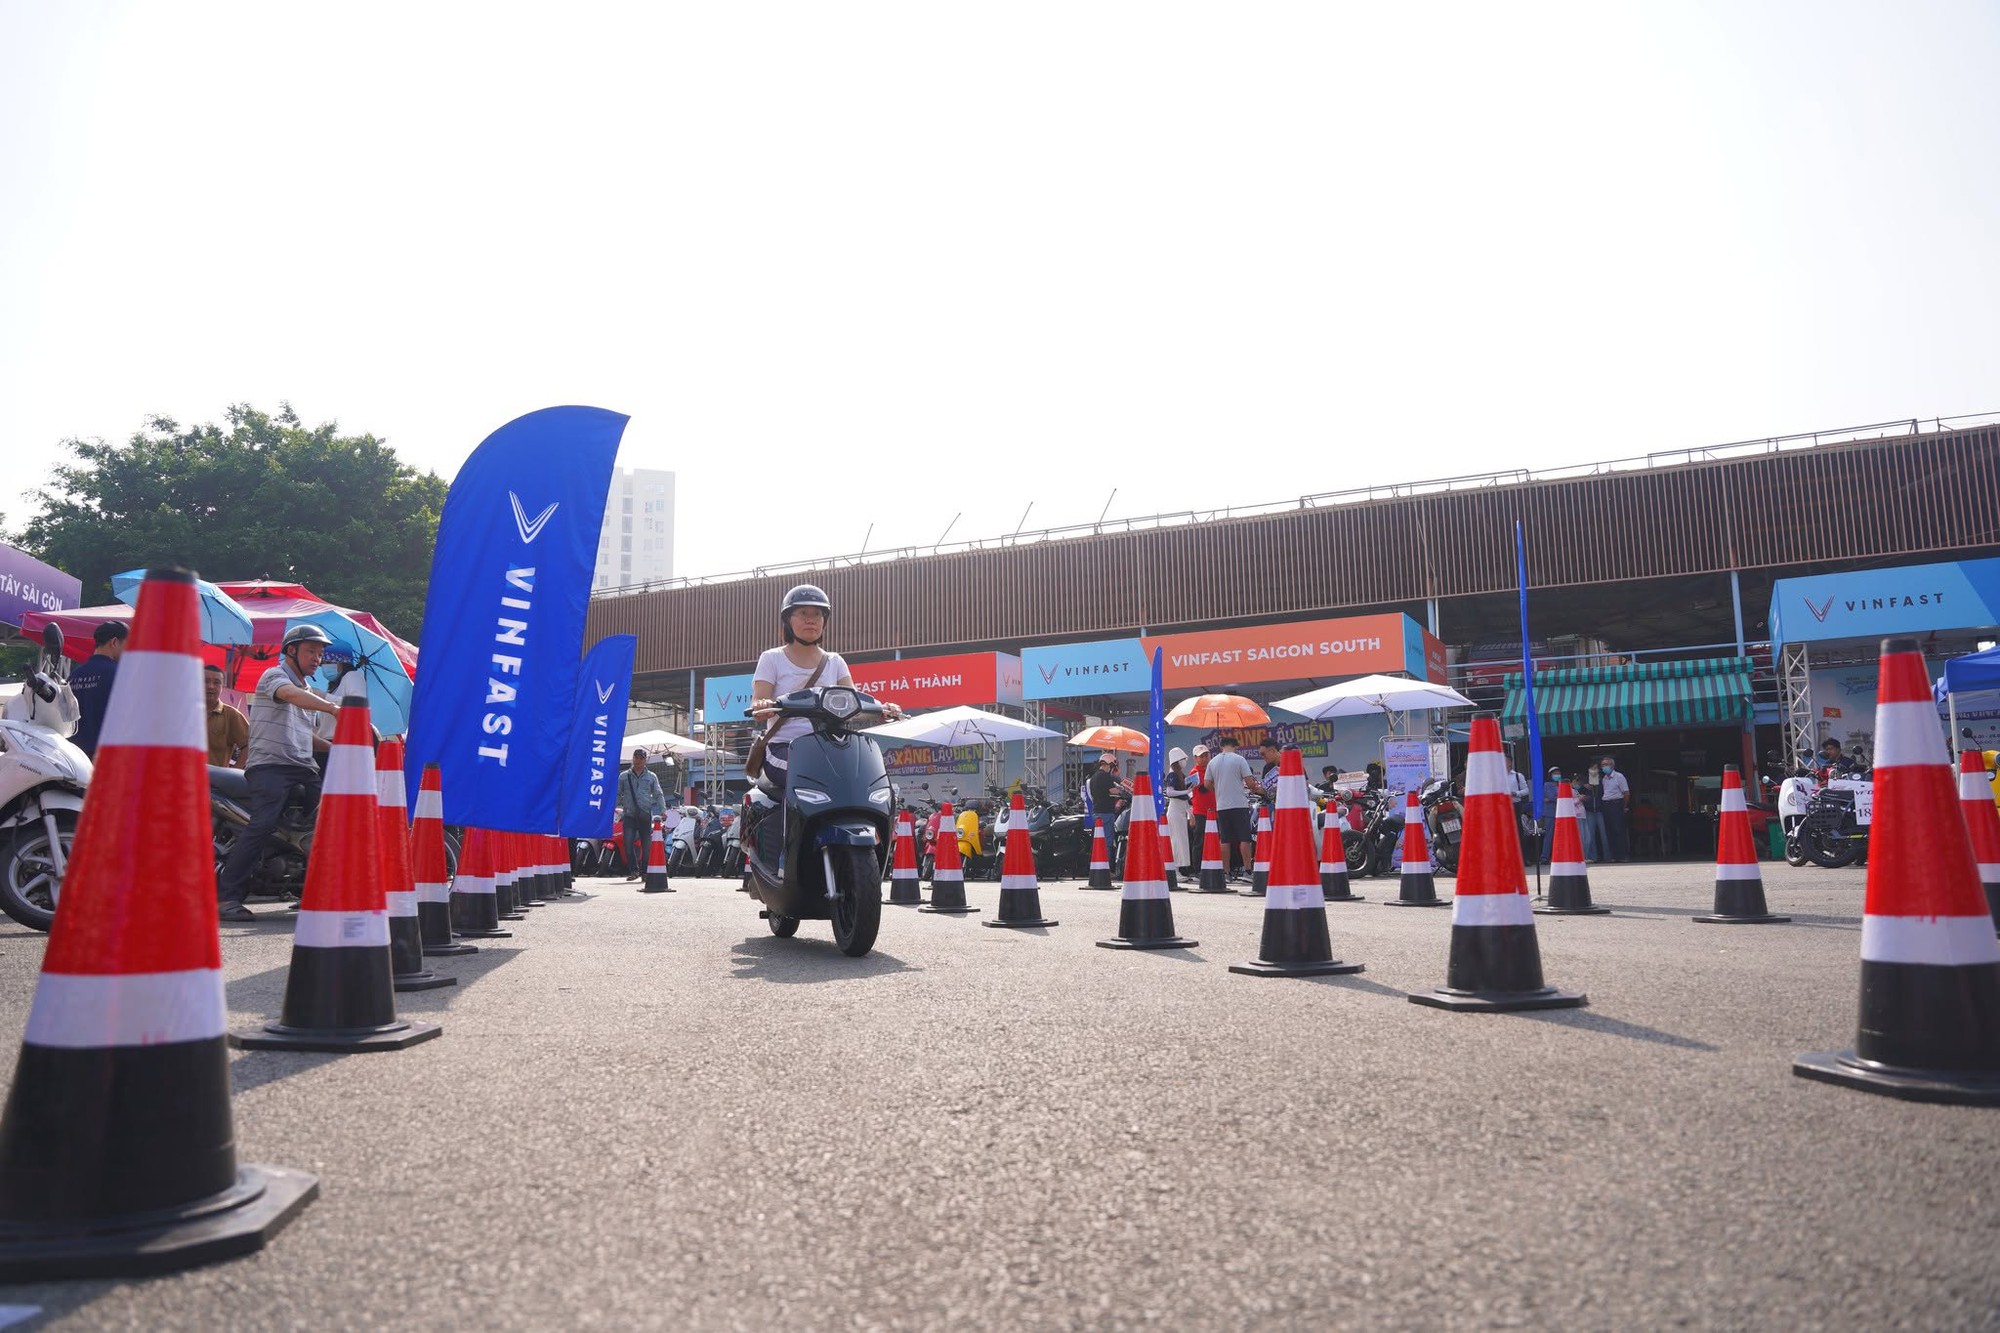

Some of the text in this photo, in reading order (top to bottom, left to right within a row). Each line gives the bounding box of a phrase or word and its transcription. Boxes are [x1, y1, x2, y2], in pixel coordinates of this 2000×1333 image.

[0, 574, 63, 612] TÂY SÀI GÒN
[1845, 592, 1943, 612] VINFAST
[478, 566, 536, 768] VINFAST
[1171, 637, 1381, 667] VINFAST SAIGON SOUTH
[890, 676, 910, 691] HÀ
[913, 674, 962, 688] THÀNH
[1065, 662, 1129, 676] VINFAST
[589, 714, 608, 810] VINFAST
